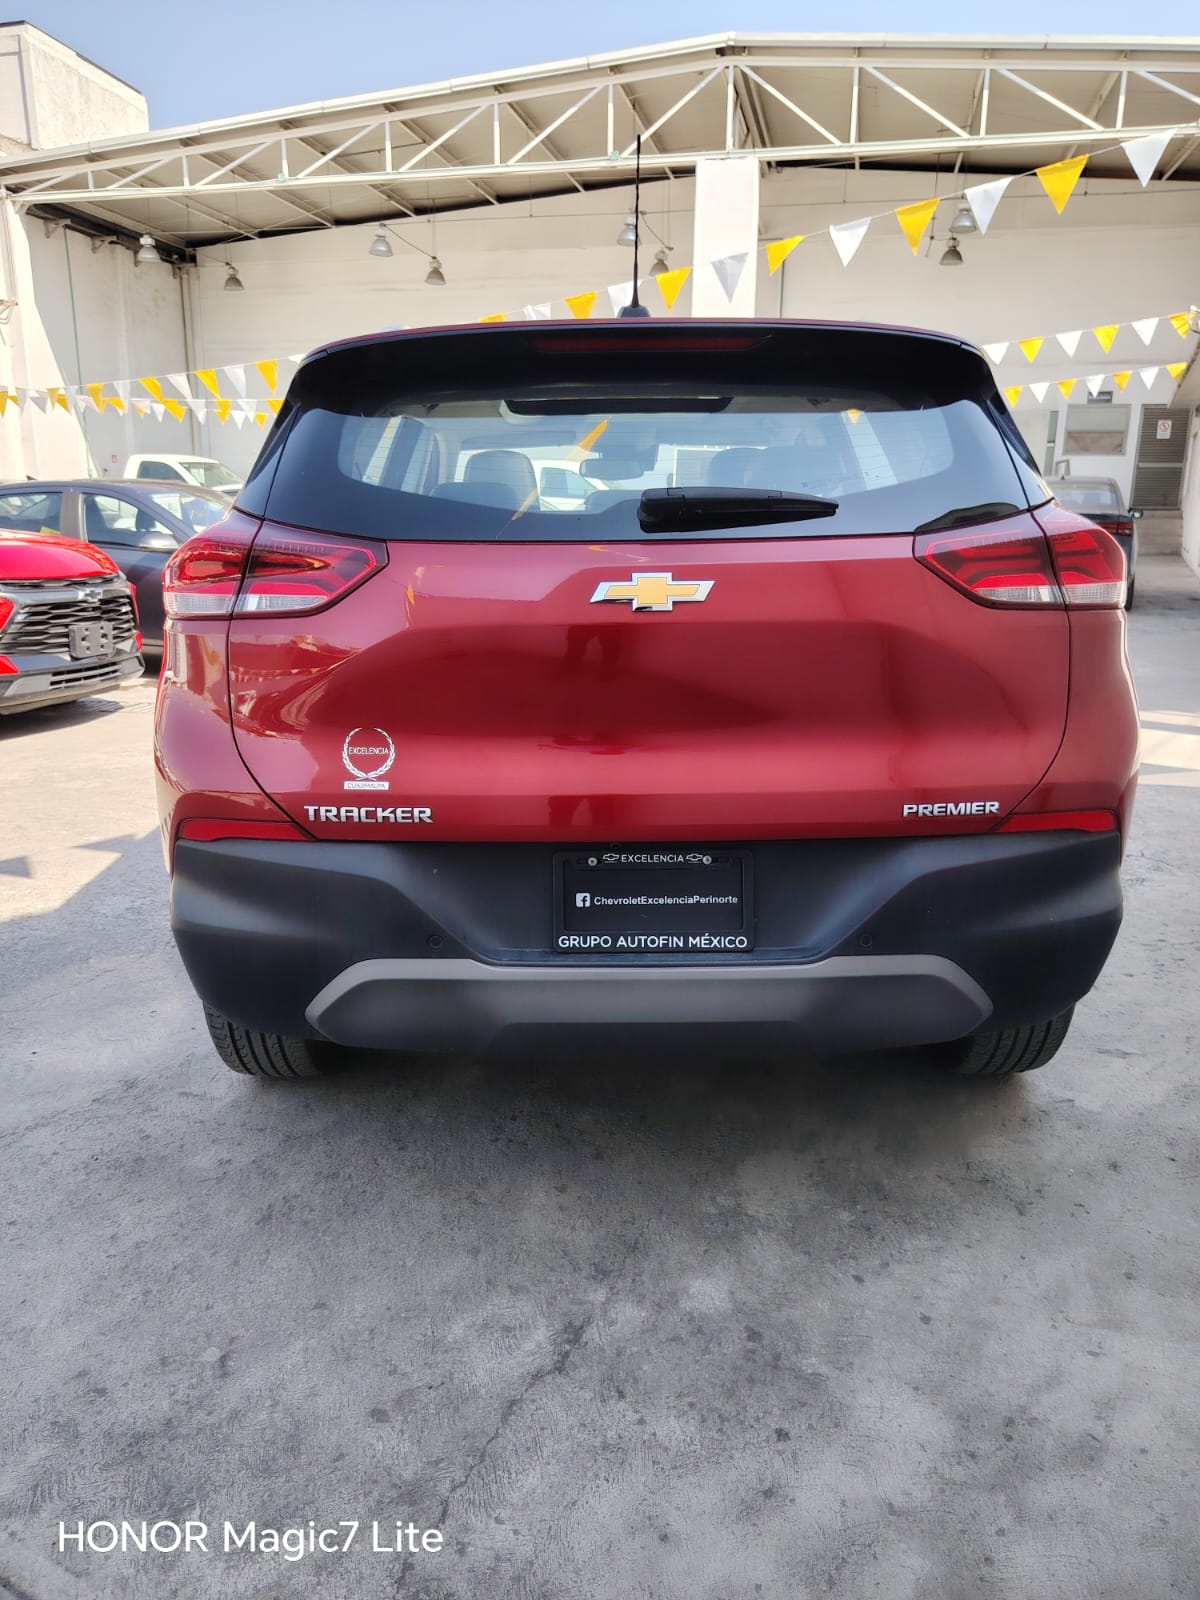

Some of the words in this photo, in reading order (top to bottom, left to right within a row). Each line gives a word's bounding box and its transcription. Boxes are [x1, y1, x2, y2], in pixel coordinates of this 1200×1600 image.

[348, 746, 389, 755] EXCELENCIA
[303, 805, 434, 823] TRACKER
[903, 801, 1000, 817] PREMIER
[621, 854, 684, 863] EXCELENCIA
[594, 894, 738, 906] ChevroletExcelenciaPerinorte
[558, 935, 612, 948] GRUPO
[616, 935, 684, 948] AUTOFIN
[688, 933, 748, 948] MÉXICO
